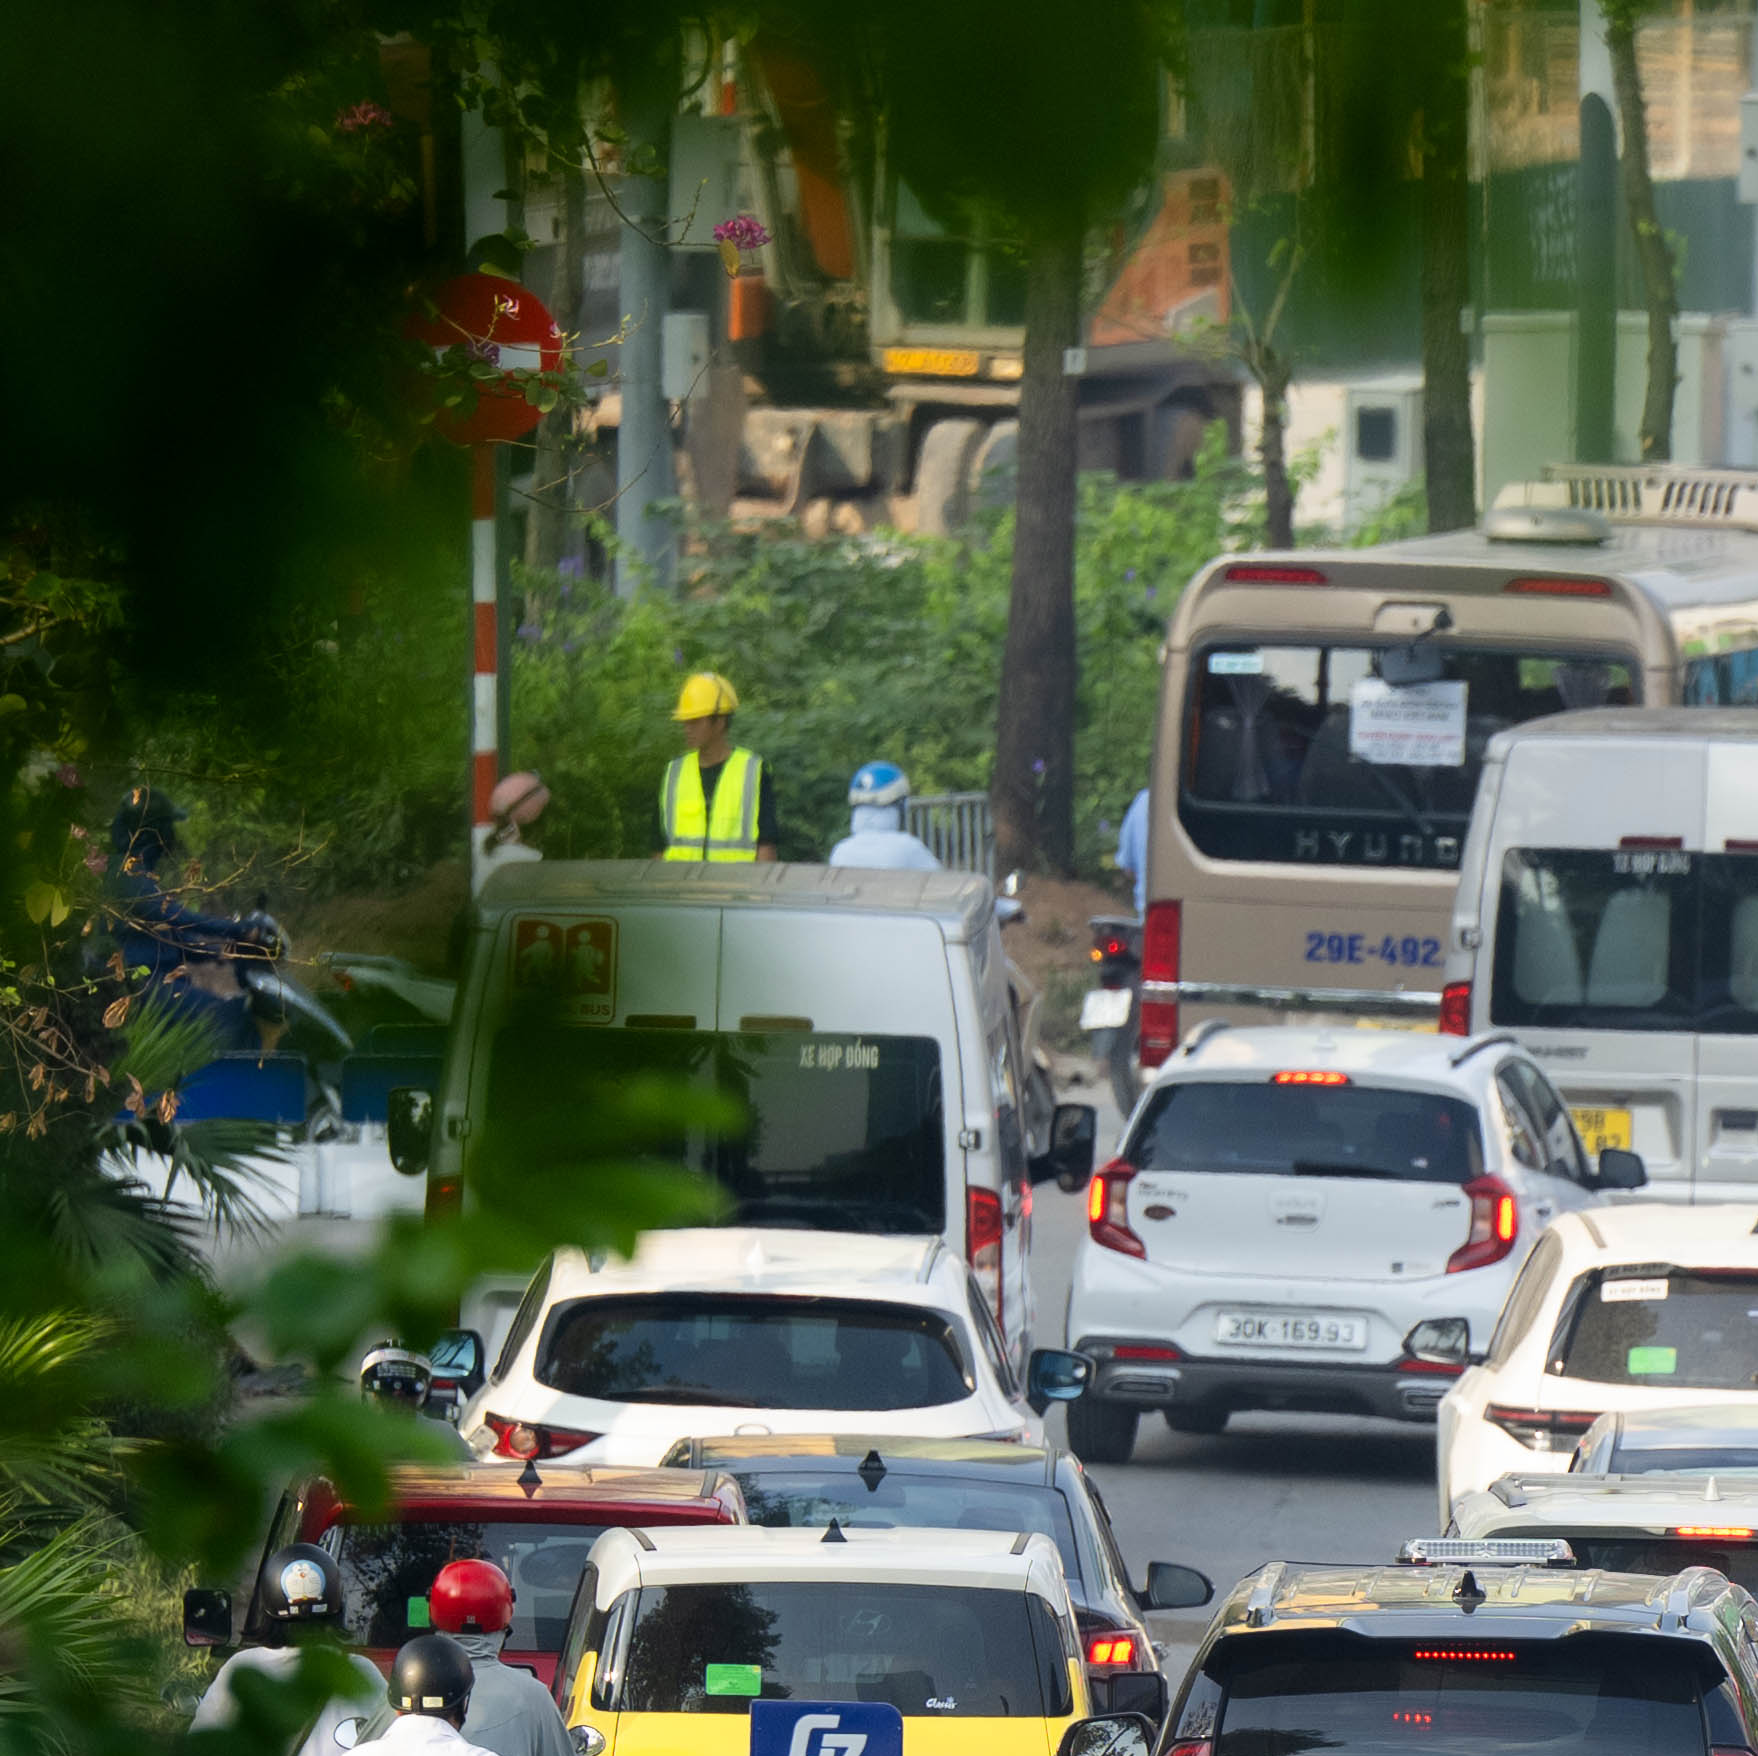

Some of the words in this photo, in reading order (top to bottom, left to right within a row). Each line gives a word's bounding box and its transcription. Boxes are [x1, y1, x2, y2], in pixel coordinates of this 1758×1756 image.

[1297, 832, 1461, 864] HYUND
[1304, 932, 1446, 968] 29E-492.
[799, 1044, 816, 1069] XE
